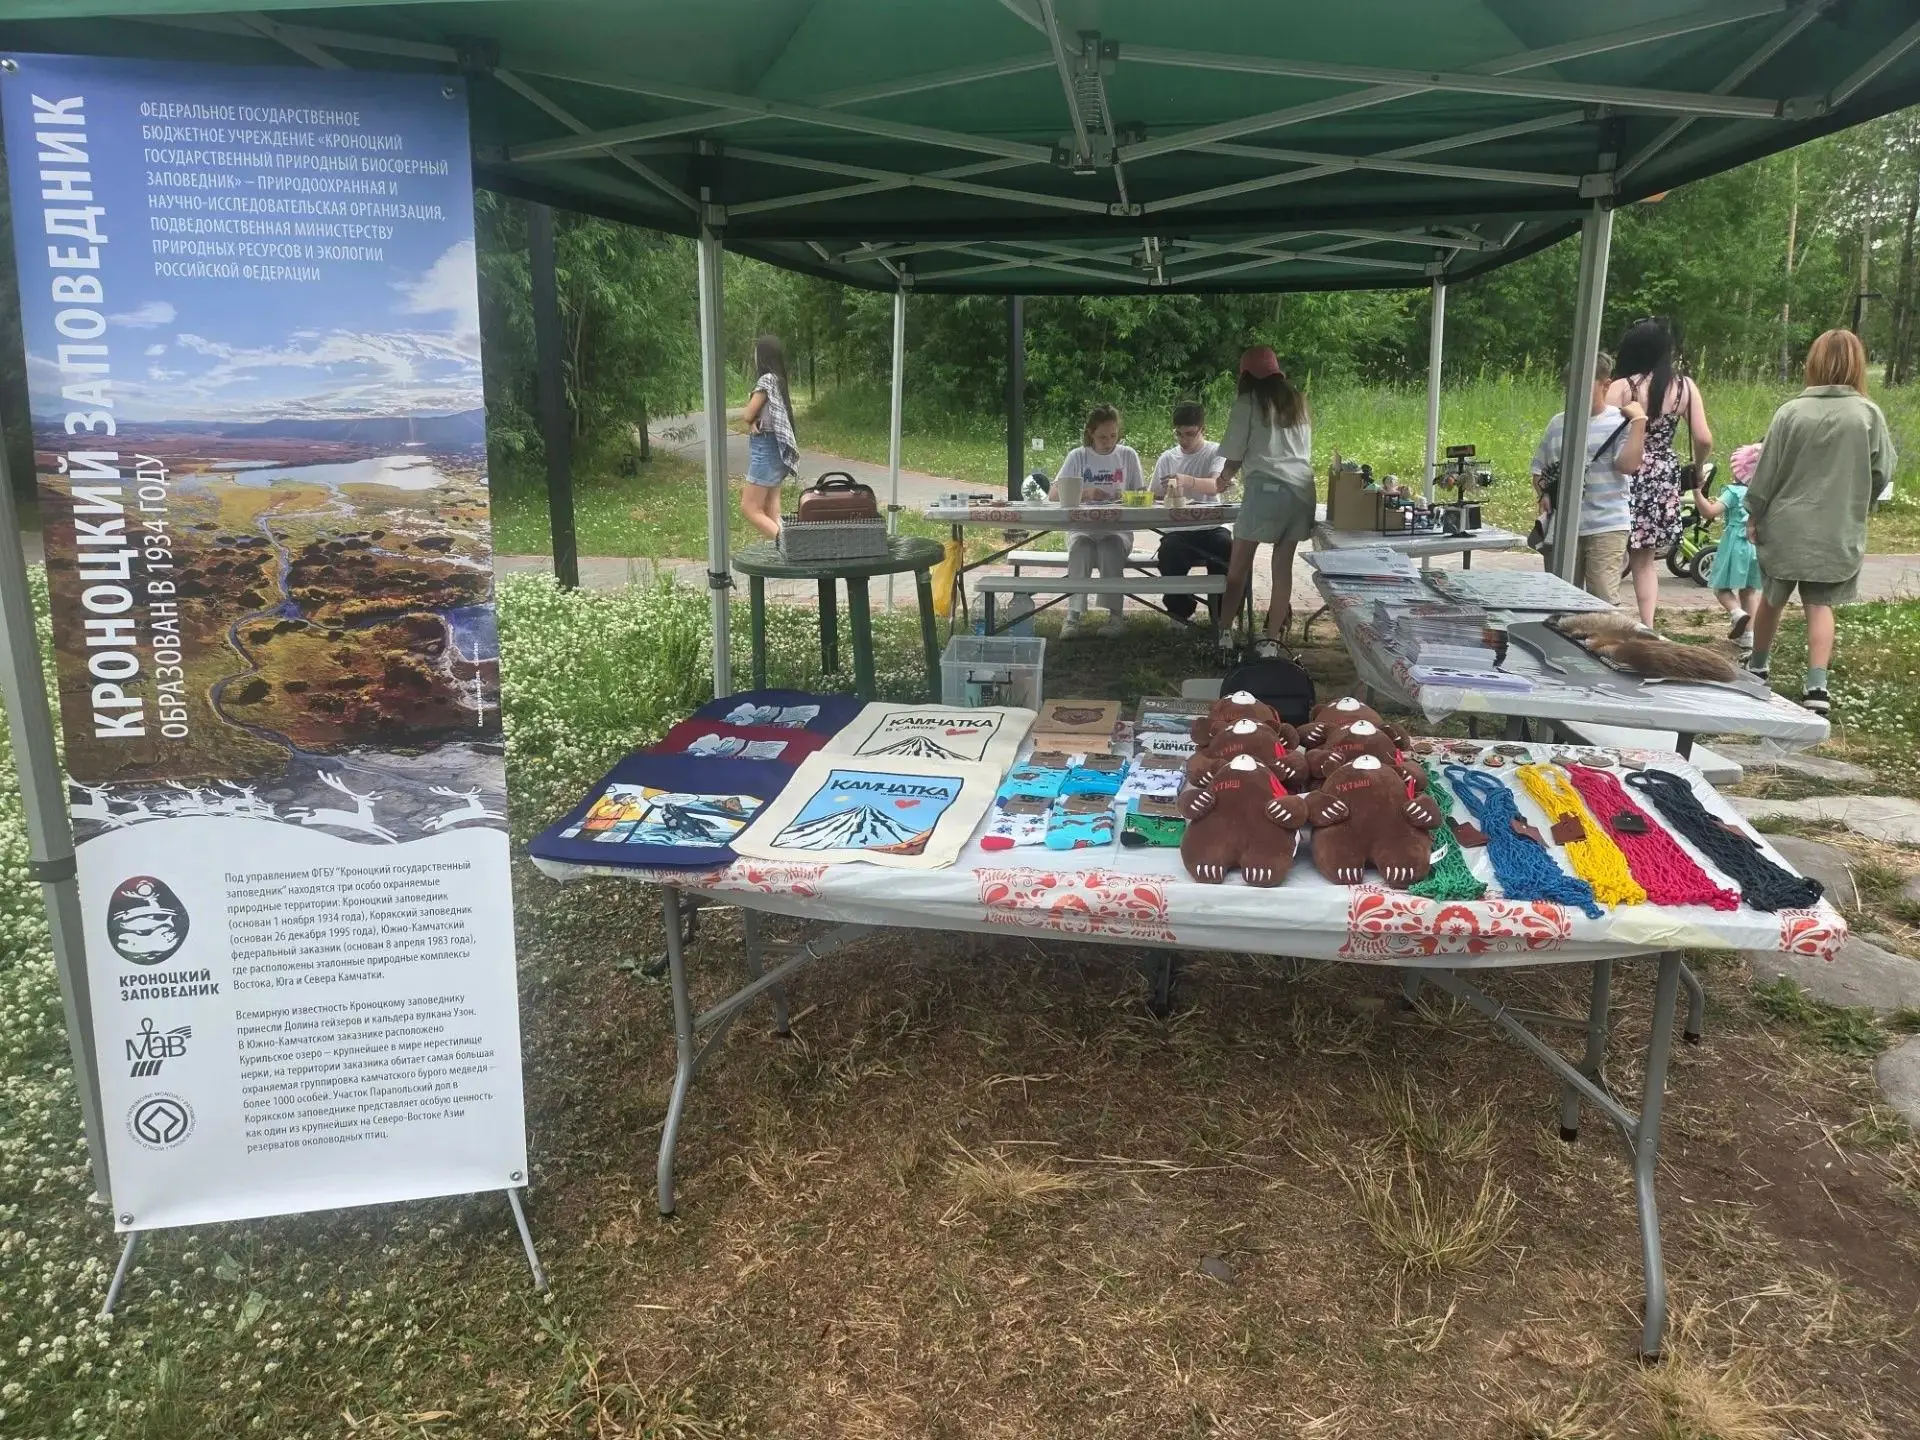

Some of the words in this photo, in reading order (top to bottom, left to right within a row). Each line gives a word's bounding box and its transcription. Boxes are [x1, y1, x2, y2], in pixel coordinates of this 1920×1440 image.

[140, 100, 236, 120] ФЕДЕРАЛЬНОЕ
[238, 105, 360, 126] ГОСУДАРСТВЕННОЕ
[142, 124, 226, 142] БЮДЖЕТНОЕ
[227, 128, 315, 147] УЧРЕЖДЕНИЕ
[318, 133, 402, 151] «КРОНОЦКИЙ
[144, 147, 272, 167] ГОСУДАРСТВЕННЫЙ
[276, 153, 358, 172] ПРИРОДНЫЙ
[361, 157, 448, 175] БИОСФЕРНЫЙ
[146, 170, 242, 189] ЗАПОВЕДНИК»
[257, 175, 386, 195] ПРИРОДООХРАННАЯ
[389, 180, 398, 195] И
[148, 194, 346, 215] НАУЧНО-ИССЛЕДОВАТЕЛЬСКАЯ
[350, 202, 445, 221] ОРГАНИЗАЦИЯ,
[150, 216, 290, 235] ПОДВЕДОМСТВЕННАЯ
[294, 222, 393, 239] МИНИСТЕРСТВУ
[152, 239, 235, 256] ПРИРОДНЫХ
[238, 242, 302, 258] РЕСУРСОВ
[304, 245, 314, 259] И
[316, 246, 383, 261] ЭКОЛОГИИ
[31, 94, 117, 437] ЗАПОВЕДНИК
[154, 260, 239, 278] РОССИЙСКОЙ
[242, 264, 320, 282] ФЕДЕРАЦИИ
[134, 453, 171, 511] ГОДУ
[142, 519, 173, 573] 1934
[57, 451, 146, 738] КРОНОЦКИЙ
[147, 580, 176, 594] В
[150, 602, 189, 739] ОБРАЗОВАН
[889, 717, 993, 728] КАМЧАТКА
[1152, 742, 1196, 752] КАМЧАТК
[830, 779, 950, 798] КАМЧАТКА
[224, 872, 244, 883] Под
[245, 870, 310, 884] управлением
[311, 866, 335, 878] ФГБУ
[392, 860, 470, 875] государственный
[288, 884, 335, 894] находятся
[336, 883, 353, 893] три
[354, 879, 381, 890] особо
[382, 878, 440, 890] охраняемые
[226, 902, 282, 915] природные
[284, 899, 340, 911] территории:
[342, 894, 392, 908] Кроноцкий
[395, 893, 448, 903] заповедник
[228, 919, 271, 930] (основан
[273, 916, 278, 925] 1
[280, 914, 315, 926] ноября
[317, 912, 339, 922] 1934
[340, 910, 368, 921] года),
[369, 907, 417, 921] Корякский
[419, 906, 472, 916] заповедник
[229, 934, 272, 945] (основан
[274, 931, 286, 941] 26
[287, 928, 326, 942] декабря
[328, 926, 350, 937] 1995
[352, 926, 378, 936] года),
[380, 920, 464, 934] Южно-Камчатский
[230, 945, 296, 961] федеральный
[298, 944, 341, 954] заказник
[343, 941, 384, 952] (основан
[385, 939, 392, 948] 8
[393, 938, 425, 950] апреля
[427, 935, 448, 946] 1983
[450, 933, 476, 944] года),
[232, 966, 247, 975] где
[249, 961, 314, 975] расположены
[315, 958, 365, 968] эталонные
[366, 954, 418, 966] природные
[420, 950, 470, 960] комплексы
[119, 968, 210, 987] КРОНОЦКИЙ
[232, 979, 274, 990] Востока,
[275, 976, 294, 986] Юга
[303, 974, 336, 984] Севера
[338, 971, 384, 981] Камчатки.
[121, 983, 218, 1001] ЗАПОВЕДНИК
[235, 1008, 290, 1020] Всемирную
[291, 1003, 348, 1015] известность
[349, 999, 405, 1012] Кроноцкому
[407, 994, 464, 1006] заповеднику
[236, 1023, 282, 1036] принесли
[284, 1020, 319, 1032] Долина
[320, 1017, 362, 1027] гейзеров
[364, 1016, 370, 1024] и
[371, 1013, 414, 1023] кальдера
[415, 1010, 452, 1021] вулкана
[454, 1007, 476, 1016] Узон.
[238, 1039, 244, 1049] В
[246, 1034, 334, 1048] Южно-Камчатском
[337, 1030, 383, 1041] заказнике
[384, 1025, 444, 1039] расположено
[239, 1052, 294, 1066] Курильское
[295, 1049, 322, 1060] озеро
[333, 1043, 389, 1057] крупнейшее
[398, 1041, 422, 1051] мире
[423, 1036, 482, 1049] нерестилище
[240, 1069, 272, 1080] нерки,
[287, 1062, 340, 1076] территории
[342, 1058, 388, 1069] заказника
[390, 1055, 425, 1065] обитает
[426, 1053, 454, 1062] самая
[455, 1049, 494, 1059] большая
[241, 1081, 298, 1095] охраняемая
[300, 1075, 358, 1090] группировка
[360, 1070, 416, 1082] камчатского
[417, 1068, 448, 1080] бурого
[449, 1064, 488, 1075] медведя
[242, 1099, 270, 1108] более
[274, 1094, 295, 1105] 1000
[296, 1091, 331, 1103] особей.
[333, 1089, 368, 1099] Участок
[369, 1082, 432, 1097] Парапольский
[434, 1082, 450, 1092] дол
[244, 1111, 295, 1124] Корякском
[297, 1105, 356, 1118] заповеднике
[357, 1099, 418, 1113] представляет
[419, 1095, 451, 1106] особую
[452, 1092, 493, 1104] ценность
[245, 1129, 262, 1137] как
[263, 1126, 287, 1136] один
[288, 1125, 300, 1133] из
[301, 1119, 358, 1133] крупнейших
[360, 1118, 371, 1126] на
[372, 1111, 442, 1124] Северо-Востоке
[443, 1108, 464, 1118] Азии
[246, 1139, 300, 1154] резерватов
[301, 1132, 362, 1146] околоводных
[364, 1130, 388, 1139] птиц.
